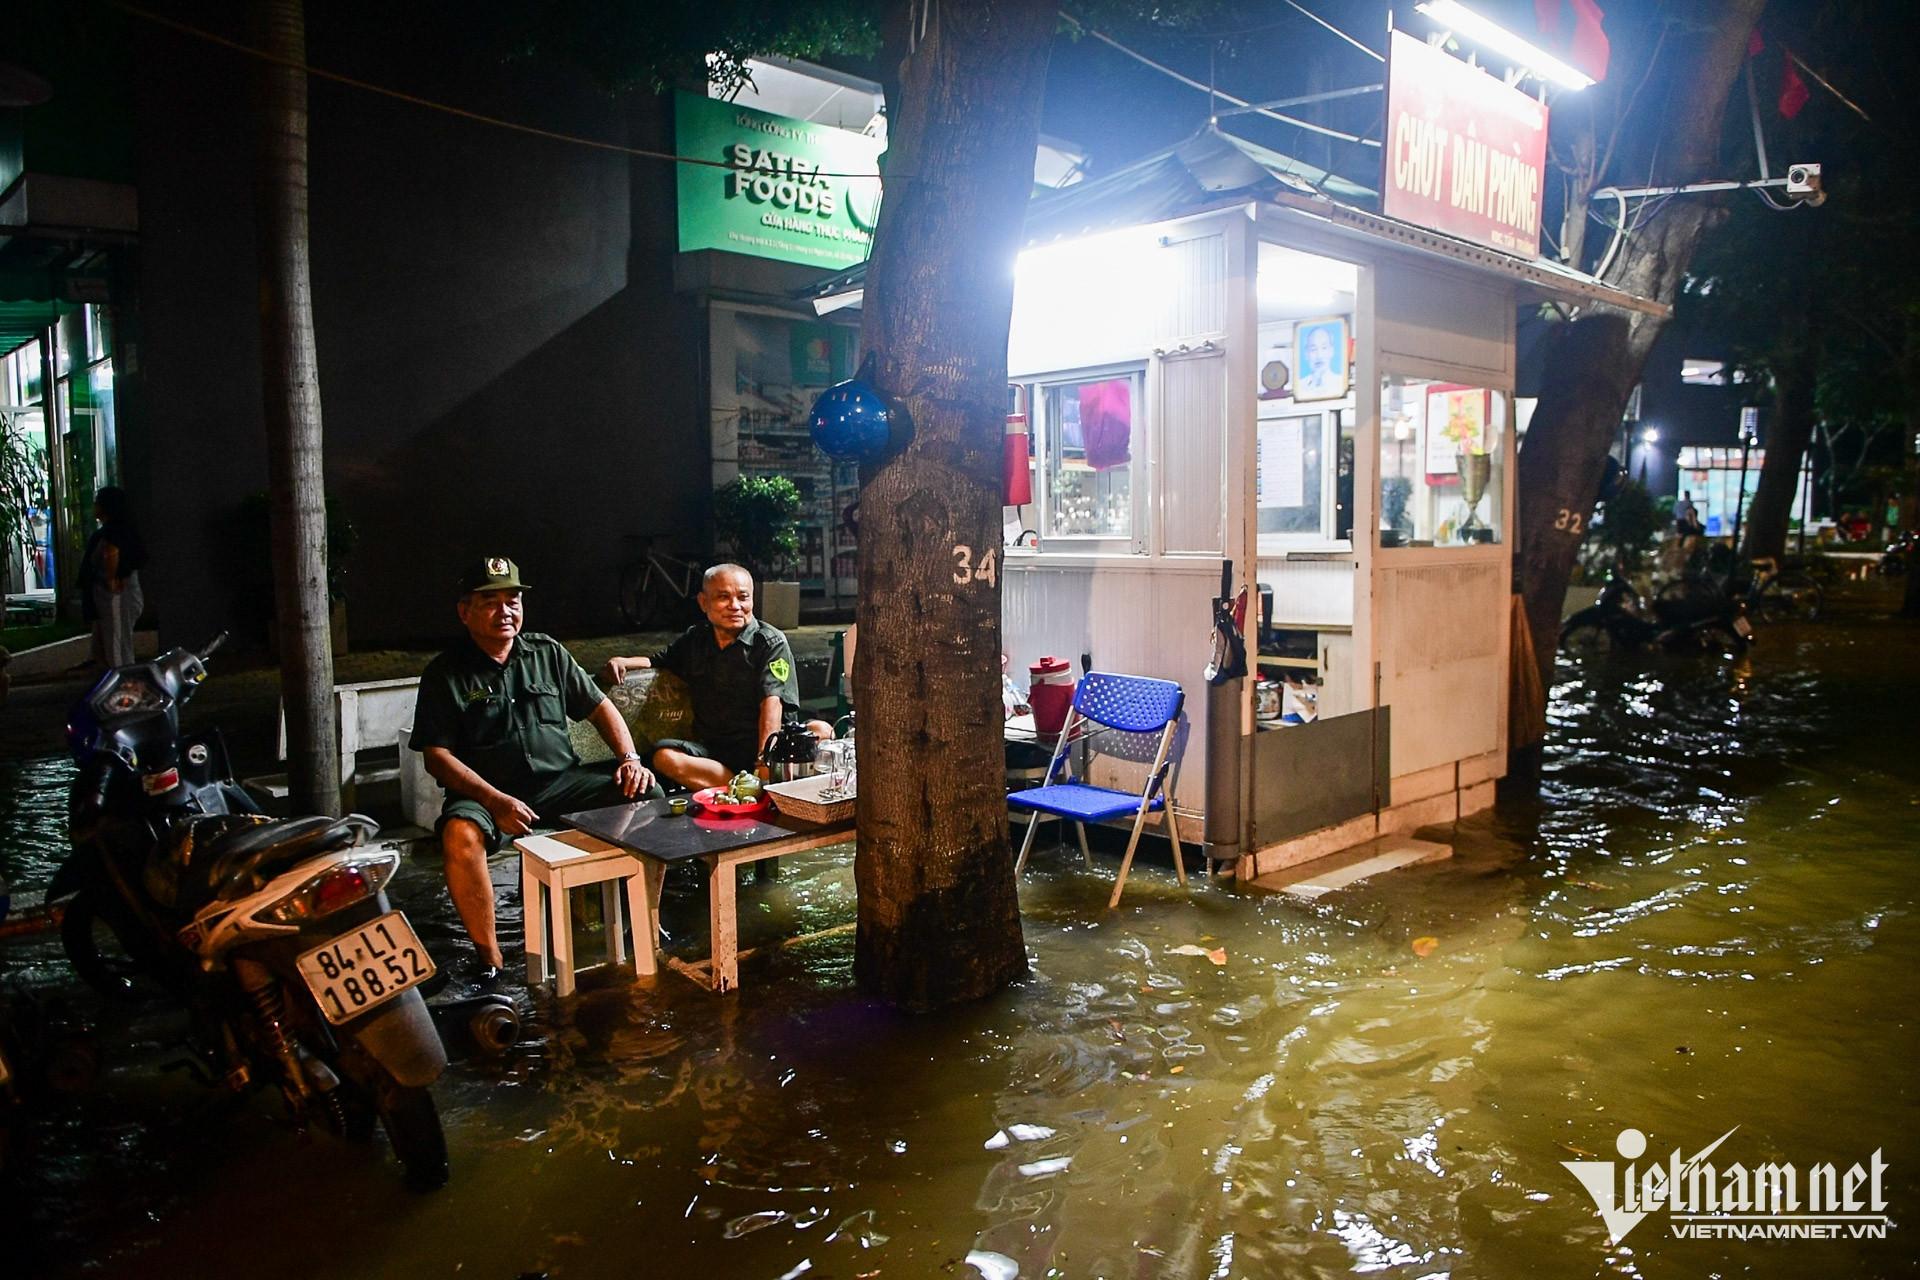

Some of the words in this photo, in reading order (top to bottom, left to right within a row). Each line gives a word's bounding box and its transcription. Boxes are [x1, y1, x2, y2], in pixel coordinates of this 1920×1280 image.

[734, 143, 832, 187] SATRA
[1451, 119, 1488, 215] DÂN
[1487, 141, 1538, 236] PHÒNG
[735, 169, 838, 215] FOODS
[1555, 508, 1582, 534] 32
[952, 544, 996, 588] 34
[324, 947, 427, 1017] 188.52
